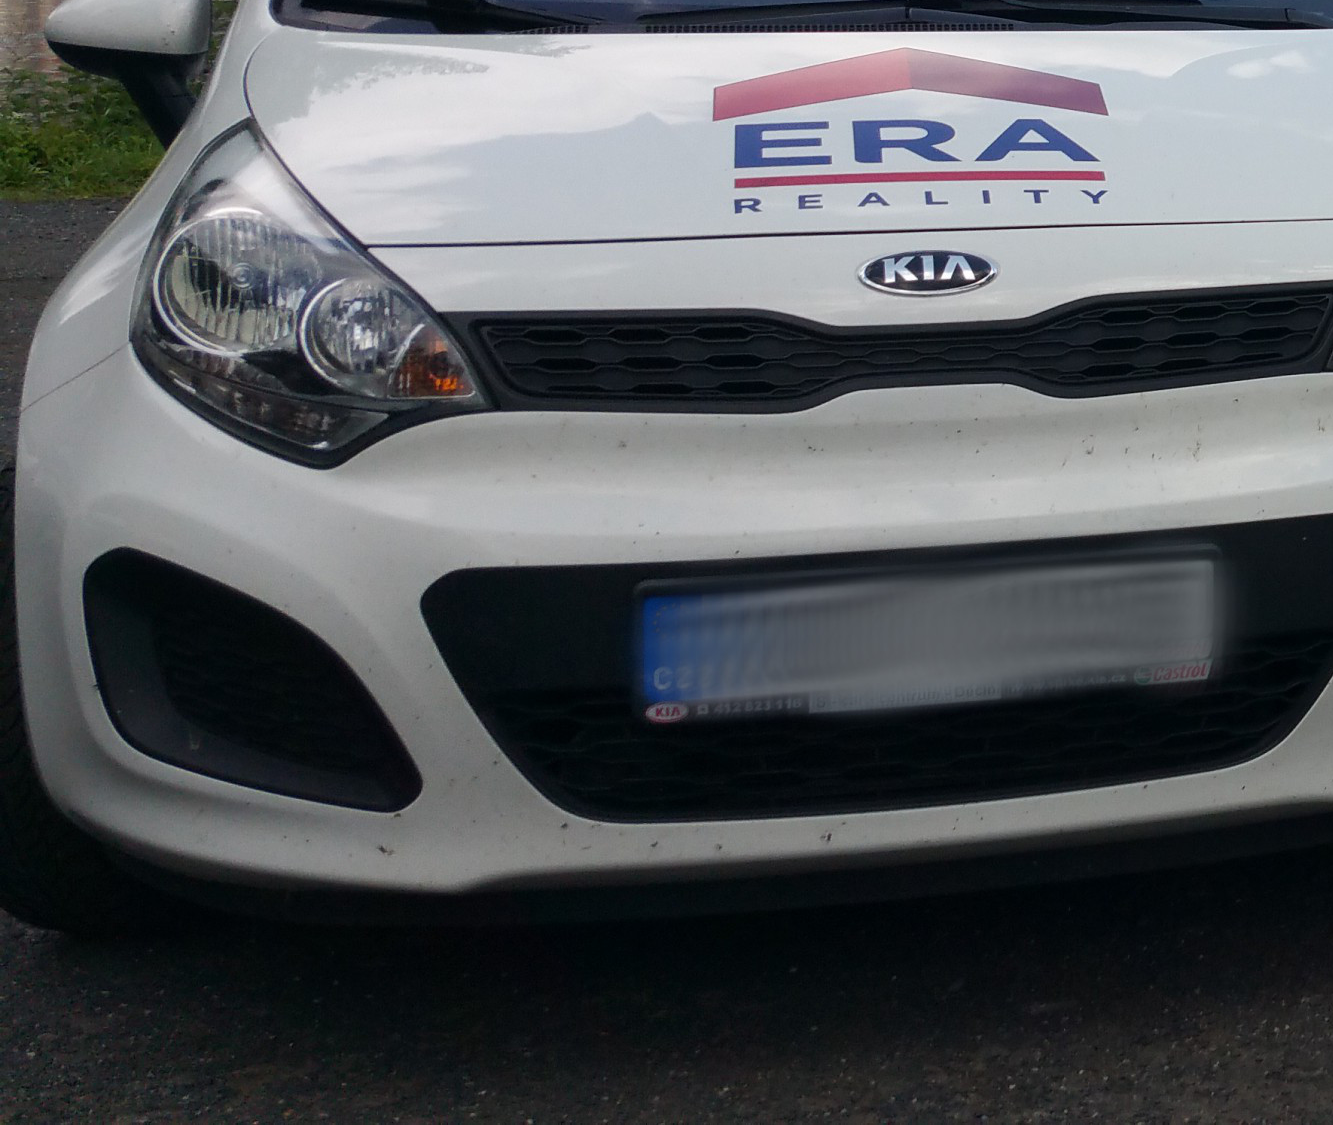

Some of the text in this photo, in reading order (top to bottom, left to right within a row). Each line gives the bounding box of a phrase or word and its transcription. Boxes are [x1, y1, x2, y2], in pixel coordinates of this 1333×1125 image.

[733, 119, 1101, 169] ERA
[733, 189, 1109, 214] REALITY
[882, 254, 977, 284] KIA
